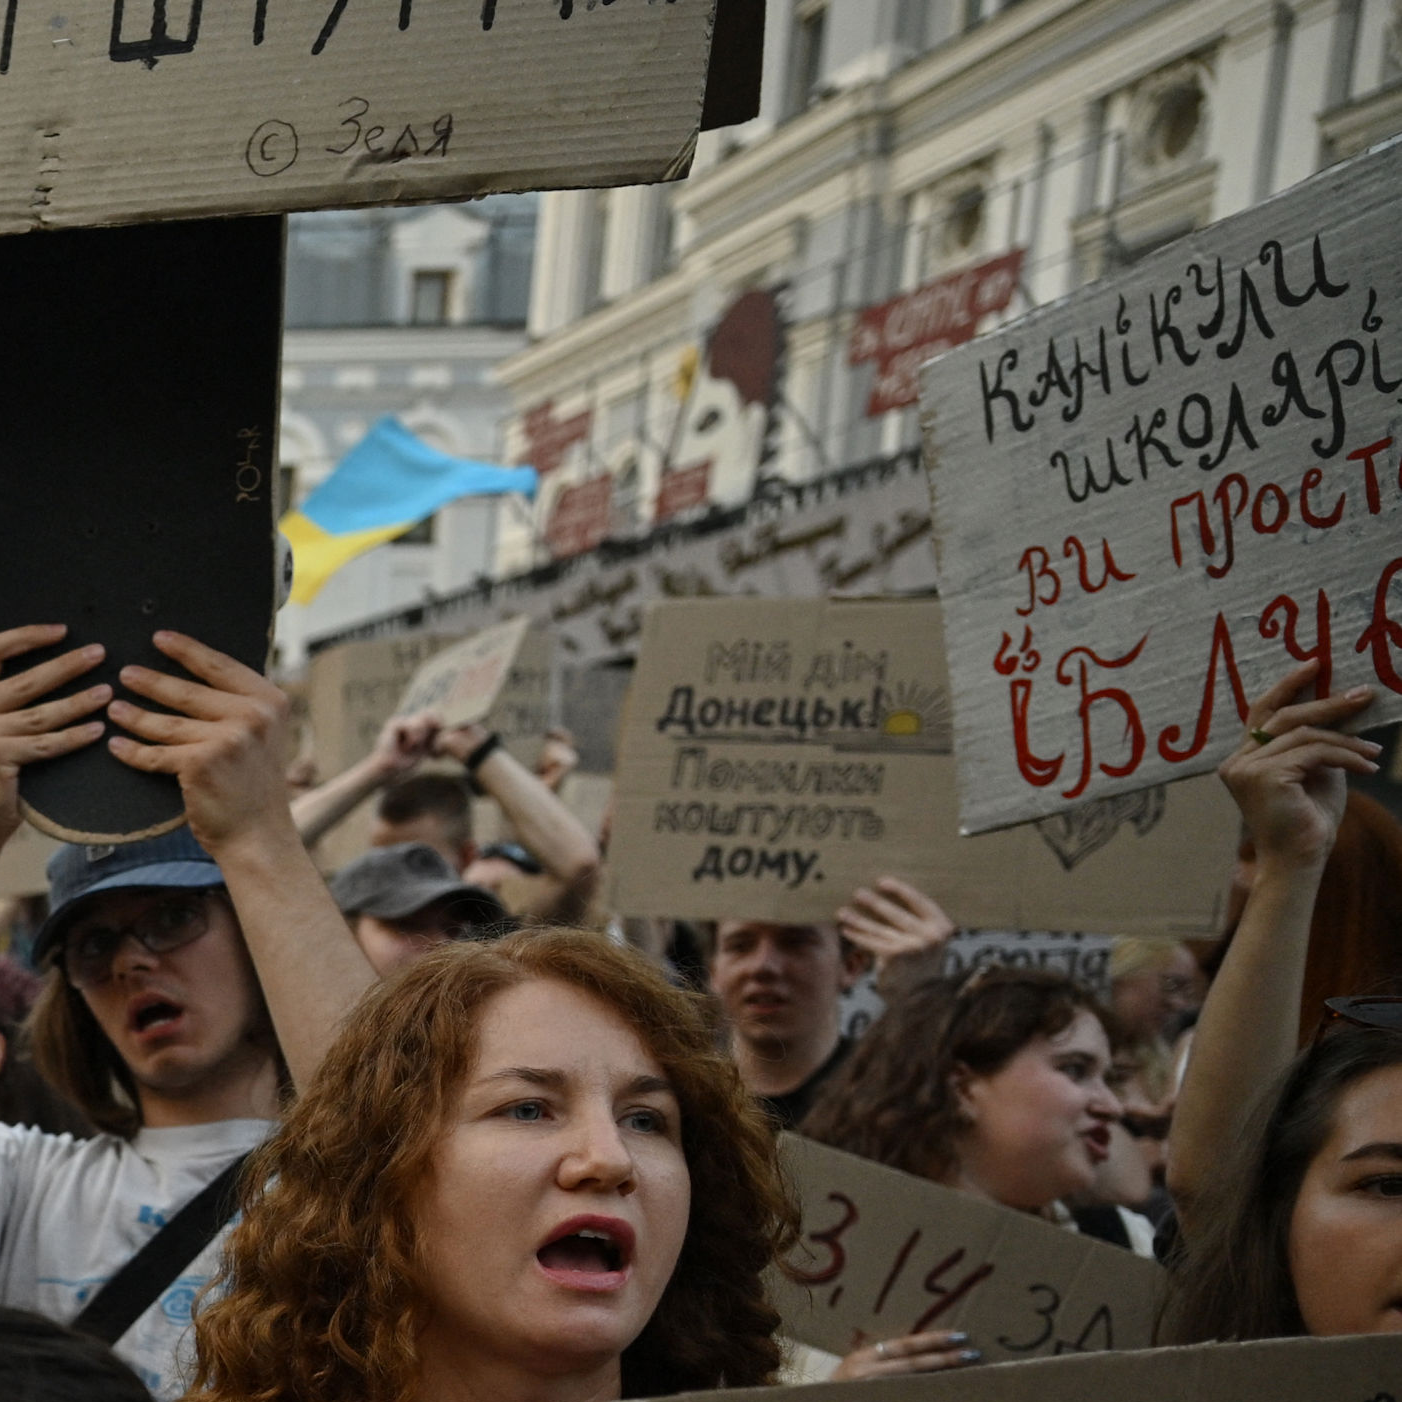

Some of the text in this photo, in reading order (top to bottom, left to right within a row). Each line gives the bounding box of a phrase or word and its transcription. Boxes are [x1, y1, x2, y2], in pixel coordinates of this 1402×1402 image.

[1017, 535, 1137, 617] ВИ
[1169, 435, 1402, 579] ПРОСТ
[703, 638, 890, 688] Мій дім
[656, 684, 884, 734] Донецьк!
[670, 745, 886, 793] Помилки
